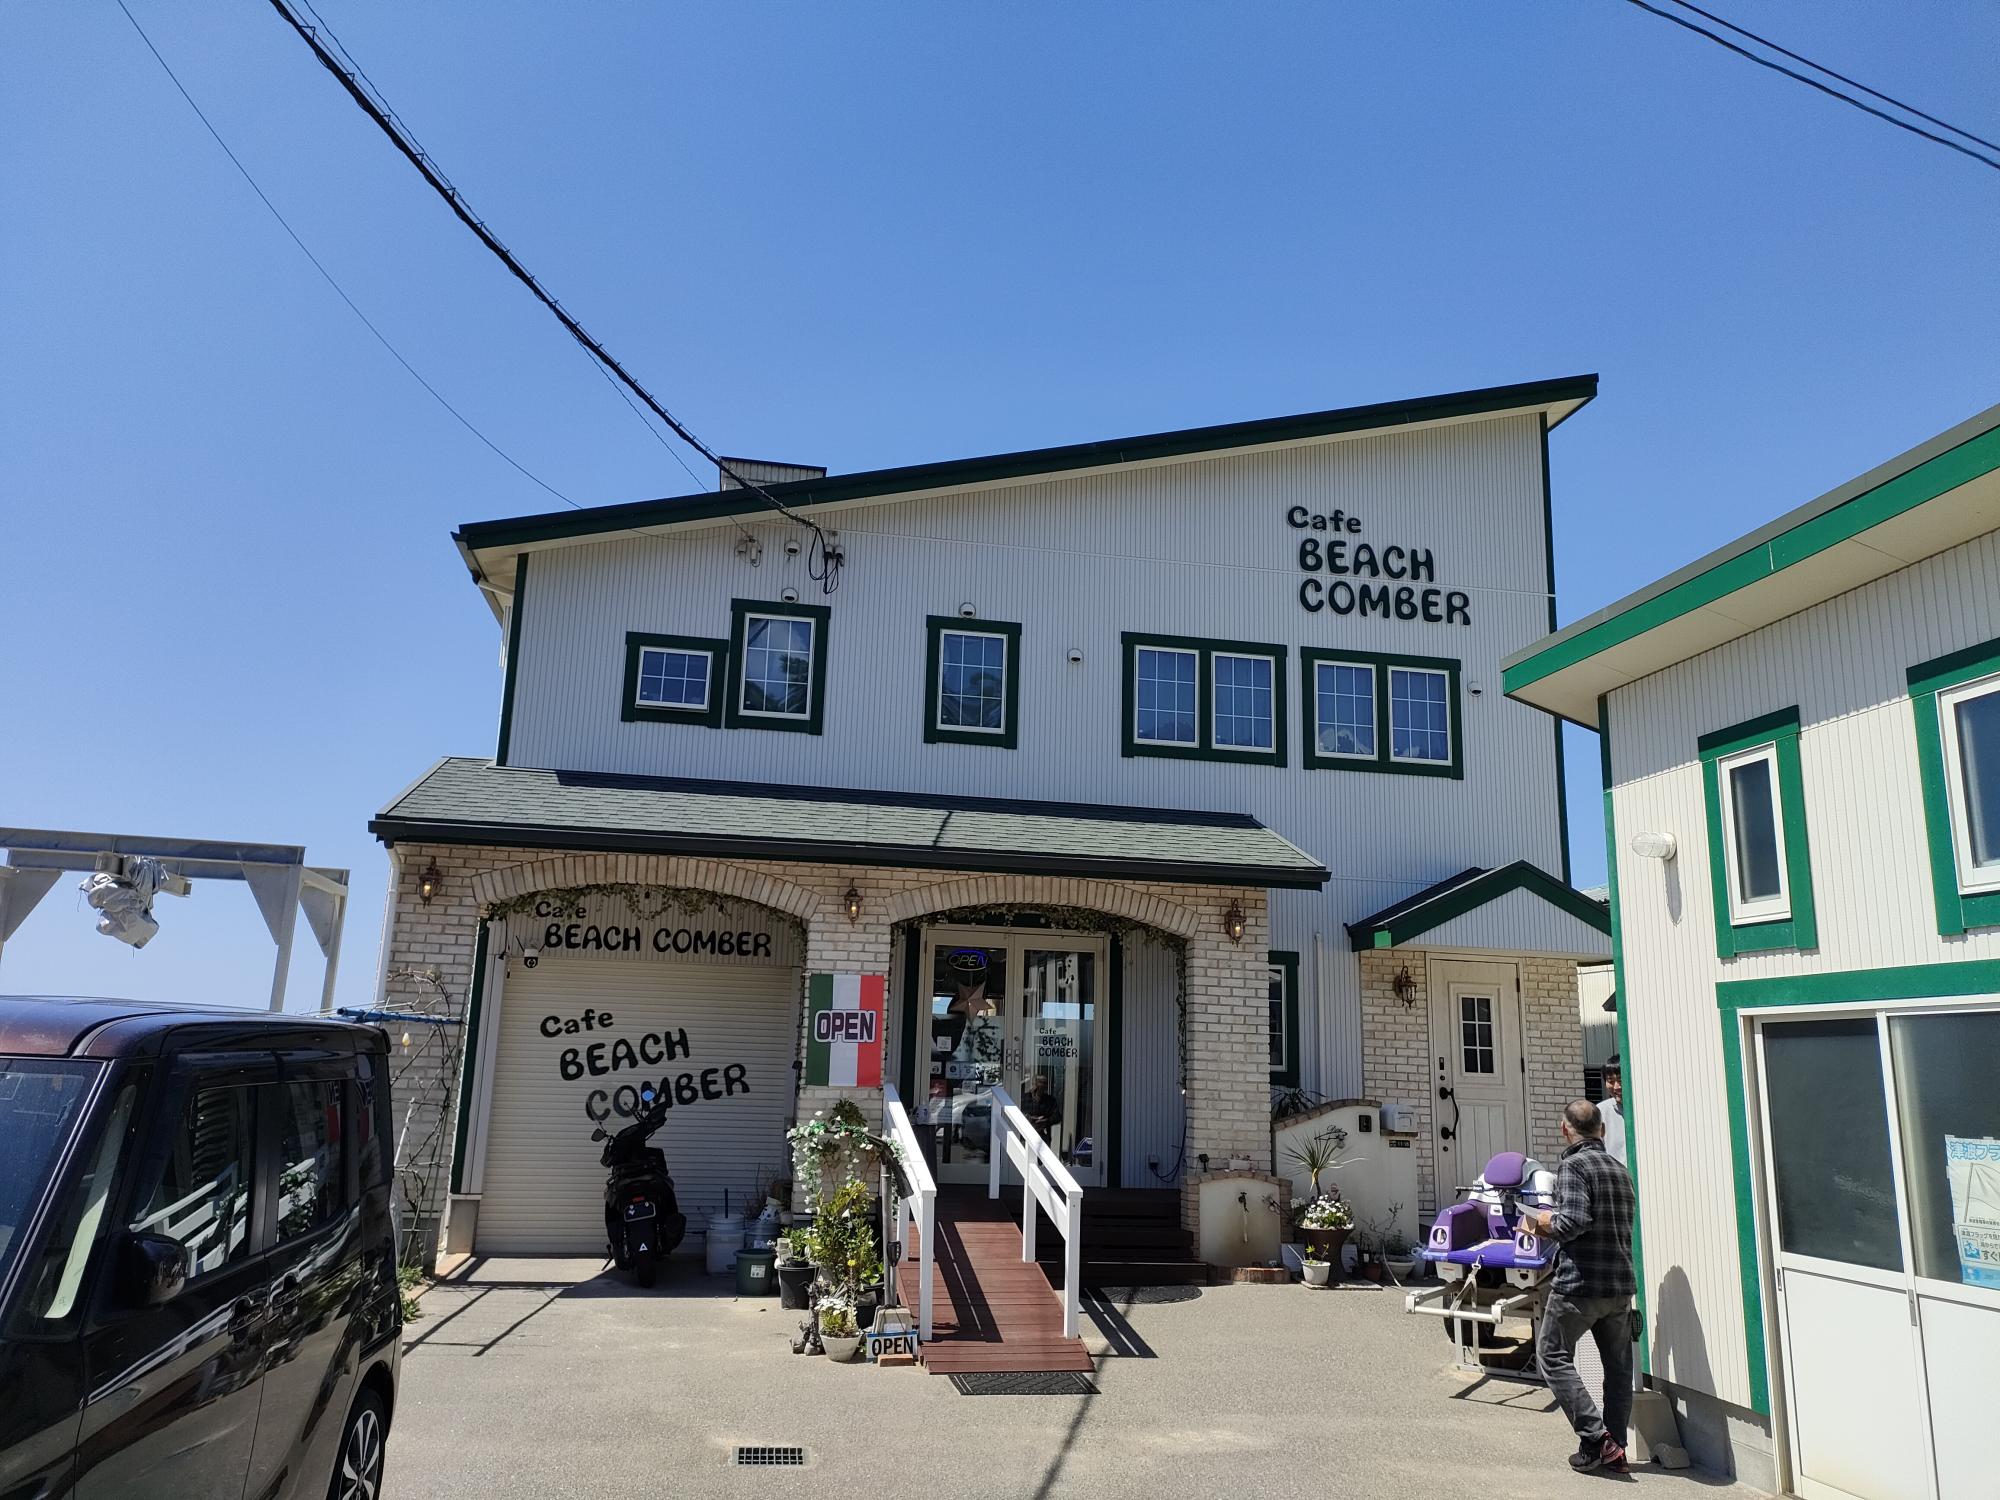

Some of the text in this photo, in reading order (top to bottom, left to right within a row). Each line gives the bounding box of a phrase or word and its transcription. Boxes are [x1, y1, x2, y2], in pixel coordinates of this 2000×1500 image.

[1287, 505, 1362, 533] Cafe
[1299, 537, 1435, 582] BEACH
[1299, 578, 1472, 625] COMBER
[535, 901, 587, 919] Cae
[544, 923, 772, 957] BEACH COMBER
[948, 954, 989, 967] OPEN
[540, 1008, 614, 1038] Cafe
[815, 1011, 875, 1041] OPEN
[1039, 1027, 1057, 1035] Cafe
[560, 1027, 690, 1081] BEACH
[1039, 1046, 1078, 1058] COMBER
[1042, 1036, 1073, 1047] BEACH
[585, 1063, 750, 1121] COMBER
[1981, 1250, 2000, 1262] すぐ
[872, 1336, 914, 1356] OPEN
